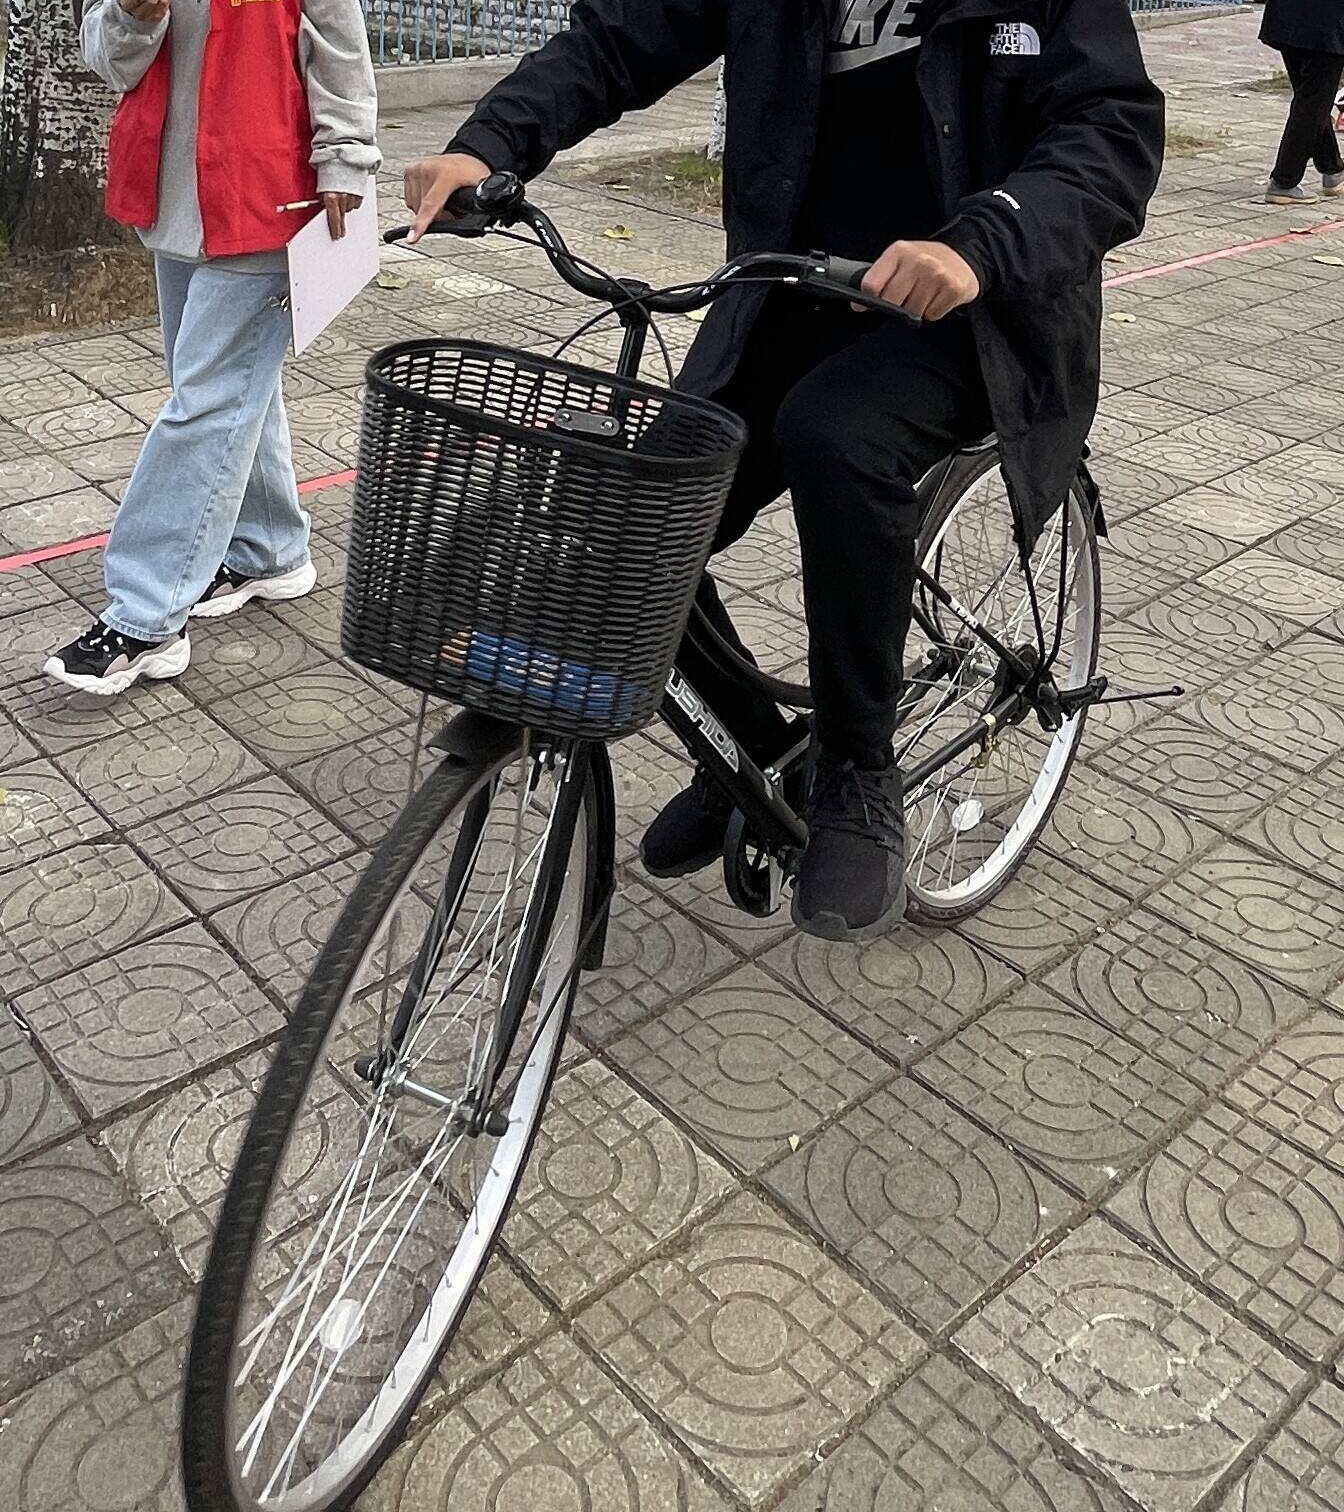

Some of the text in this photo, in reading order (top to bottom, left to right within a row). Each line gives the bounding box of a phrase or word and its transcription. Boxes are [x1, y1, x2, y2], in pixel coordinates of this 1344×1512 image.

[995, 23, 1020, 34] THE
[991, 44, 1020, 55] FACE
[665, 668, 739, 773] USHIDA
